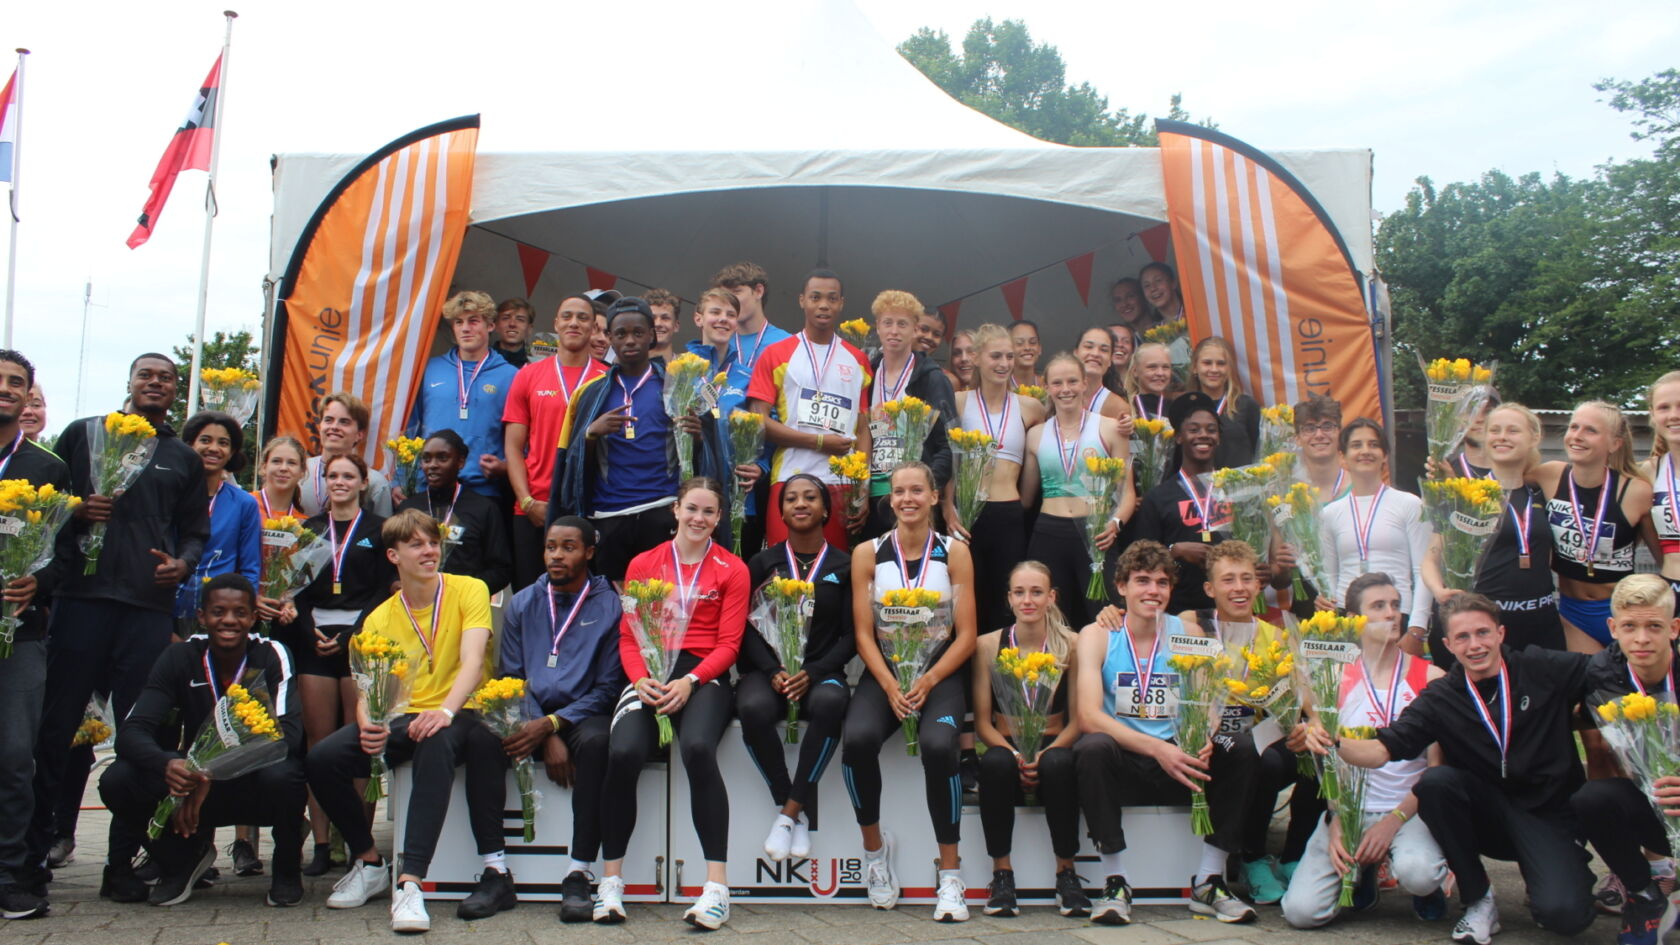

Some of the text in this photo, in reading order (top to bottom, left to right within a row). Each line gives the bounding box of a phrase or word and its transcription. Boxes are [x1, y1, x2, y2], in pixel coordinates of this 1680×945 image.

[811, 402, 840, 420] 910
[873, 449, 895, 462] 734
[1496, 594, 1556, 611] NIKE PR
[884, 608, 920, 616] TESSELAAR
[1171, 637, 1209, 647] TESSELAAR
[1303, 642, 1346, 652] TESSELAAR
[1132, 688, 1166, 704] 868
[839, 858, 862, 871] 18
[839, 871, 862, 884] 20
